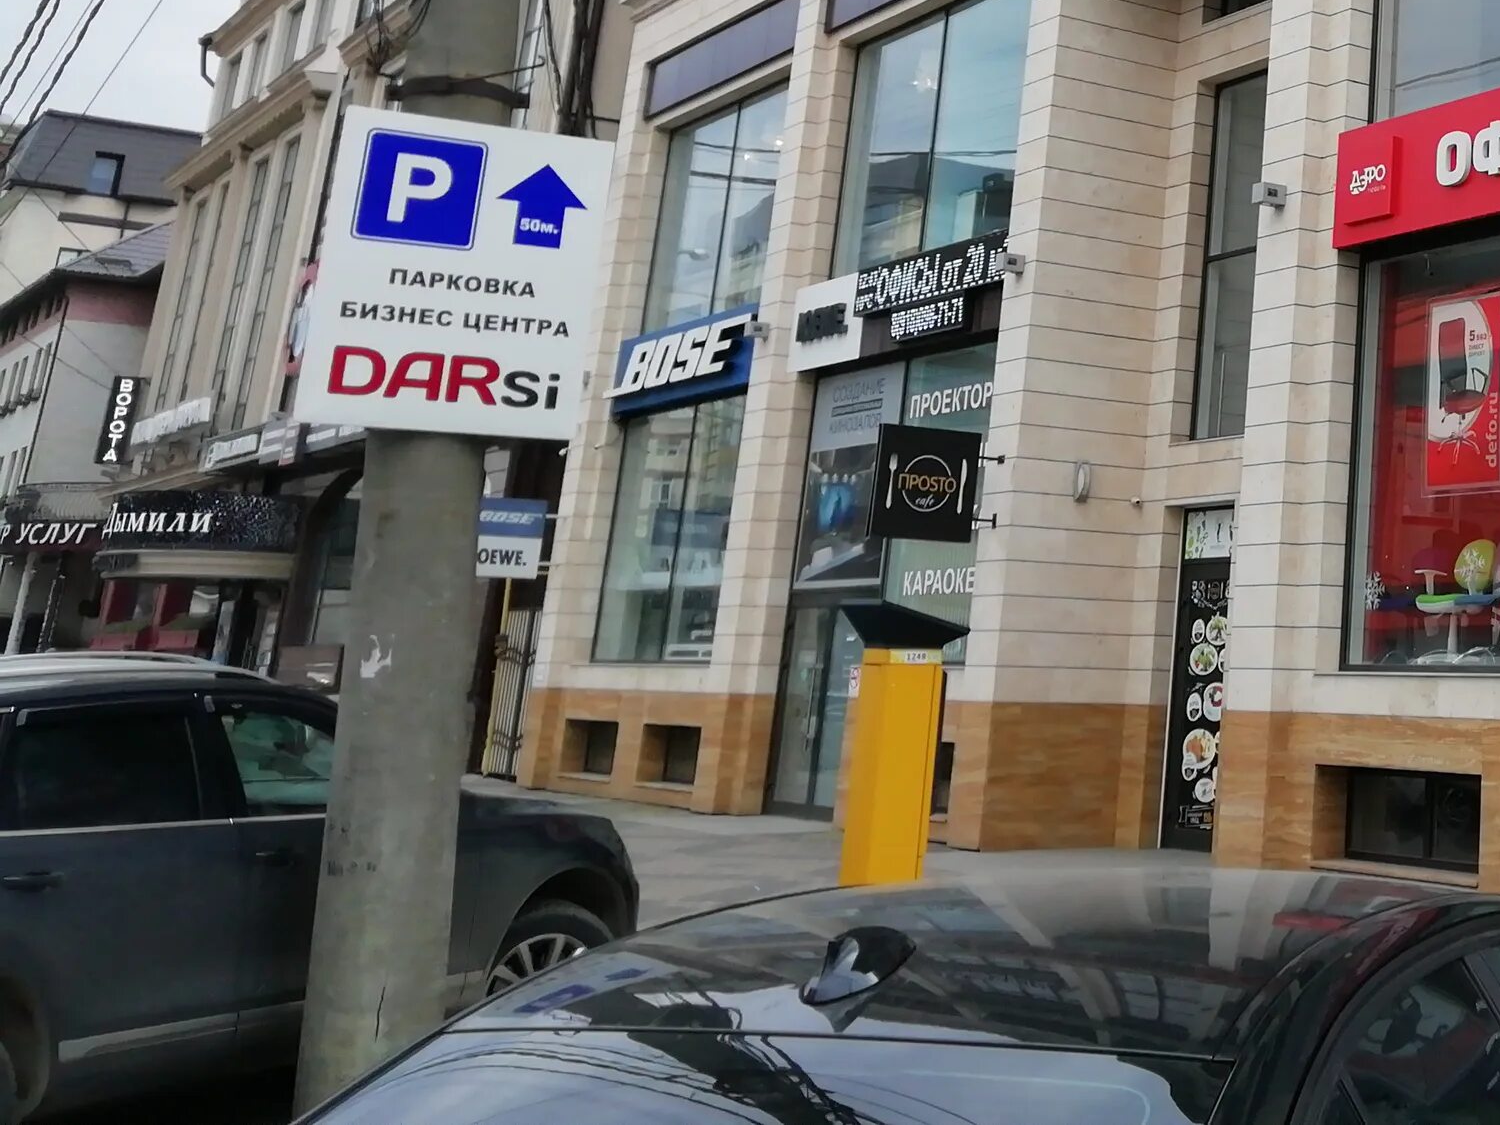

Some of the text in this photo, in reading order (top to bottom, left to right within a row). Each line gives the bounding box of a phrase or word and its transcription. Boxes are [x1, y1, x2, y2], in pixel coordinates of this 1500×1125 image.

[386, 152, 453, 224] P
[389, 268, 536, 299] ПАРКОВКА
[340, 301, 569, 338] БИЗНЕС ЦЕНТРА
[602, 312, 752, 399] BOSE
[910, 382, 993, 419] ПРОЕКТОР
[103, 378, 134, 462] ВОРОТА
[1486, 392, 1498, 467] defo.ru
[915, 494, 935, 507] cafe
[15, 523, 97, 544] УСЛУГ
[102, 502, 213, 540] Дымили
[478, 548, 526, 566] OEWE.
[903, 566, 976, 596] КАРАОКЕ
